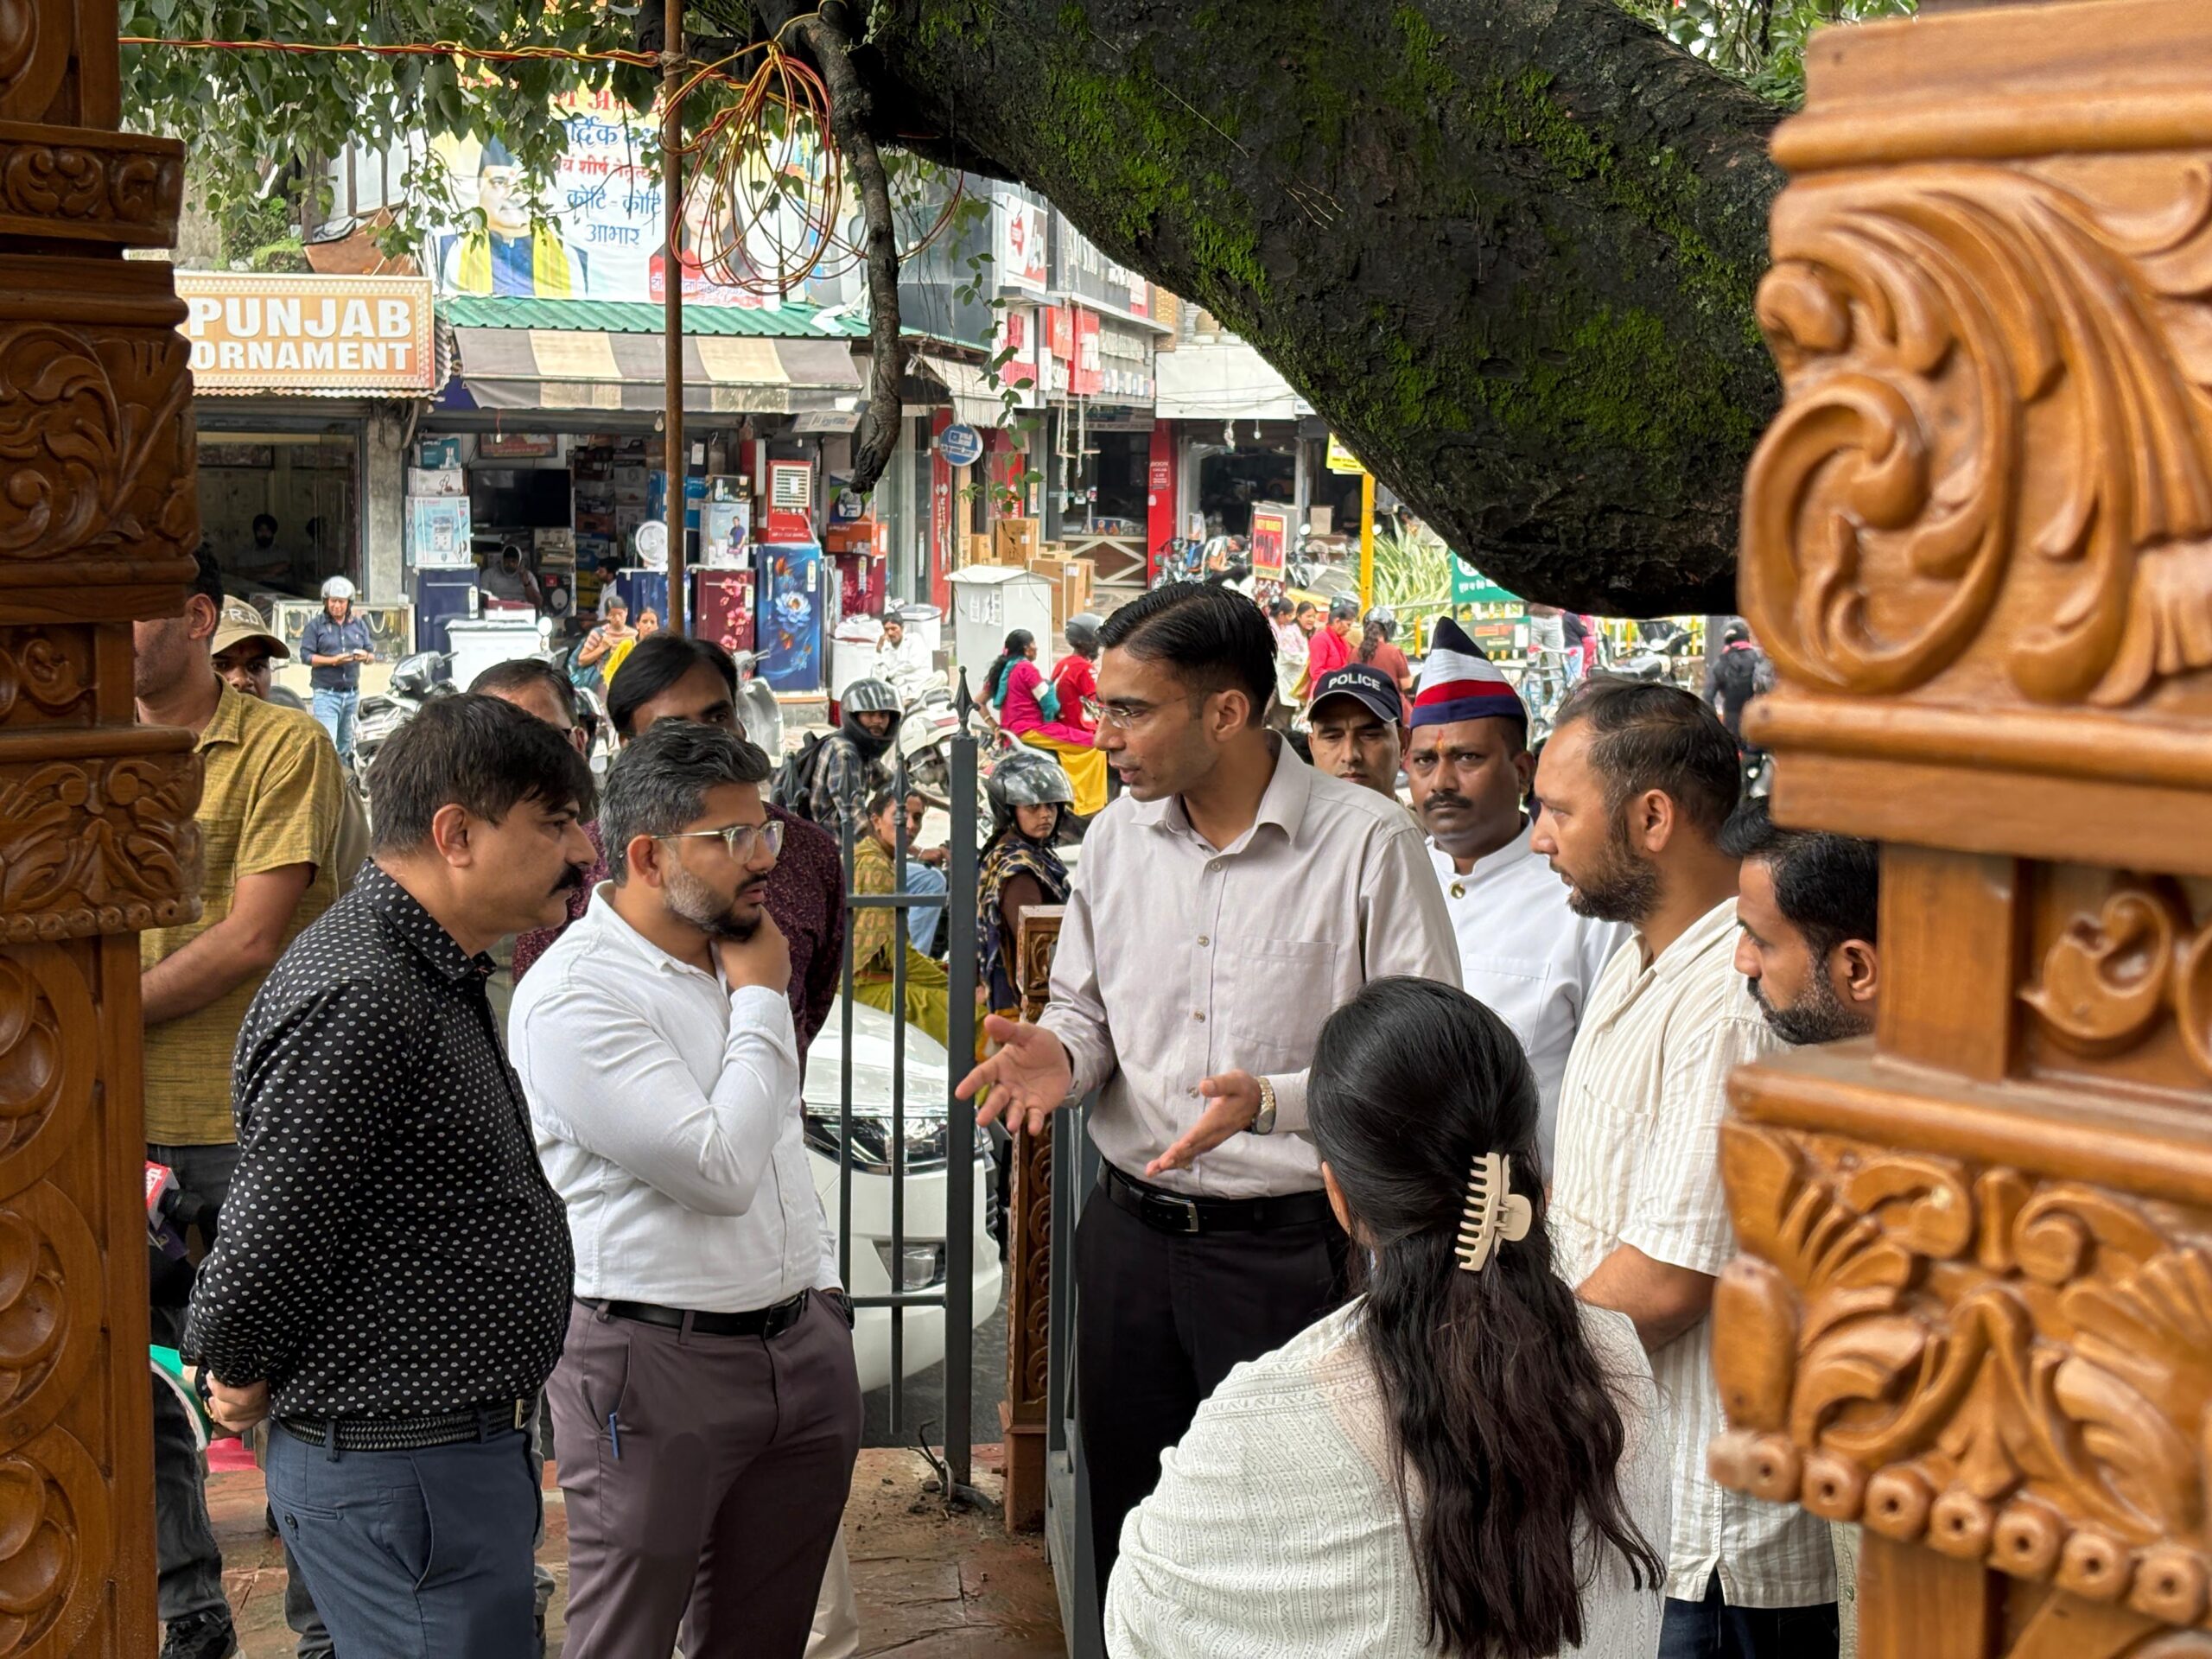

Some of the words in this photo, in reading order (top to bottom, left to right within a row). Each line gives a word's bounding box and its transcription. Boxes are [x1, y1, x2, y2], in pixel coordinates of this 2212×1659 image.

[579, 155, 609, 175] शीर्ष
[567, 184, 607, 210] कोटि
[622, 189, 662, 215] कोटि
[586, 223, 640, 245] आभार
[189, 297, 411, 338] PUNJAB
[191, 341, 412, 370] ORNAMENT
[1328, 673, 1381, 691] POLICE
